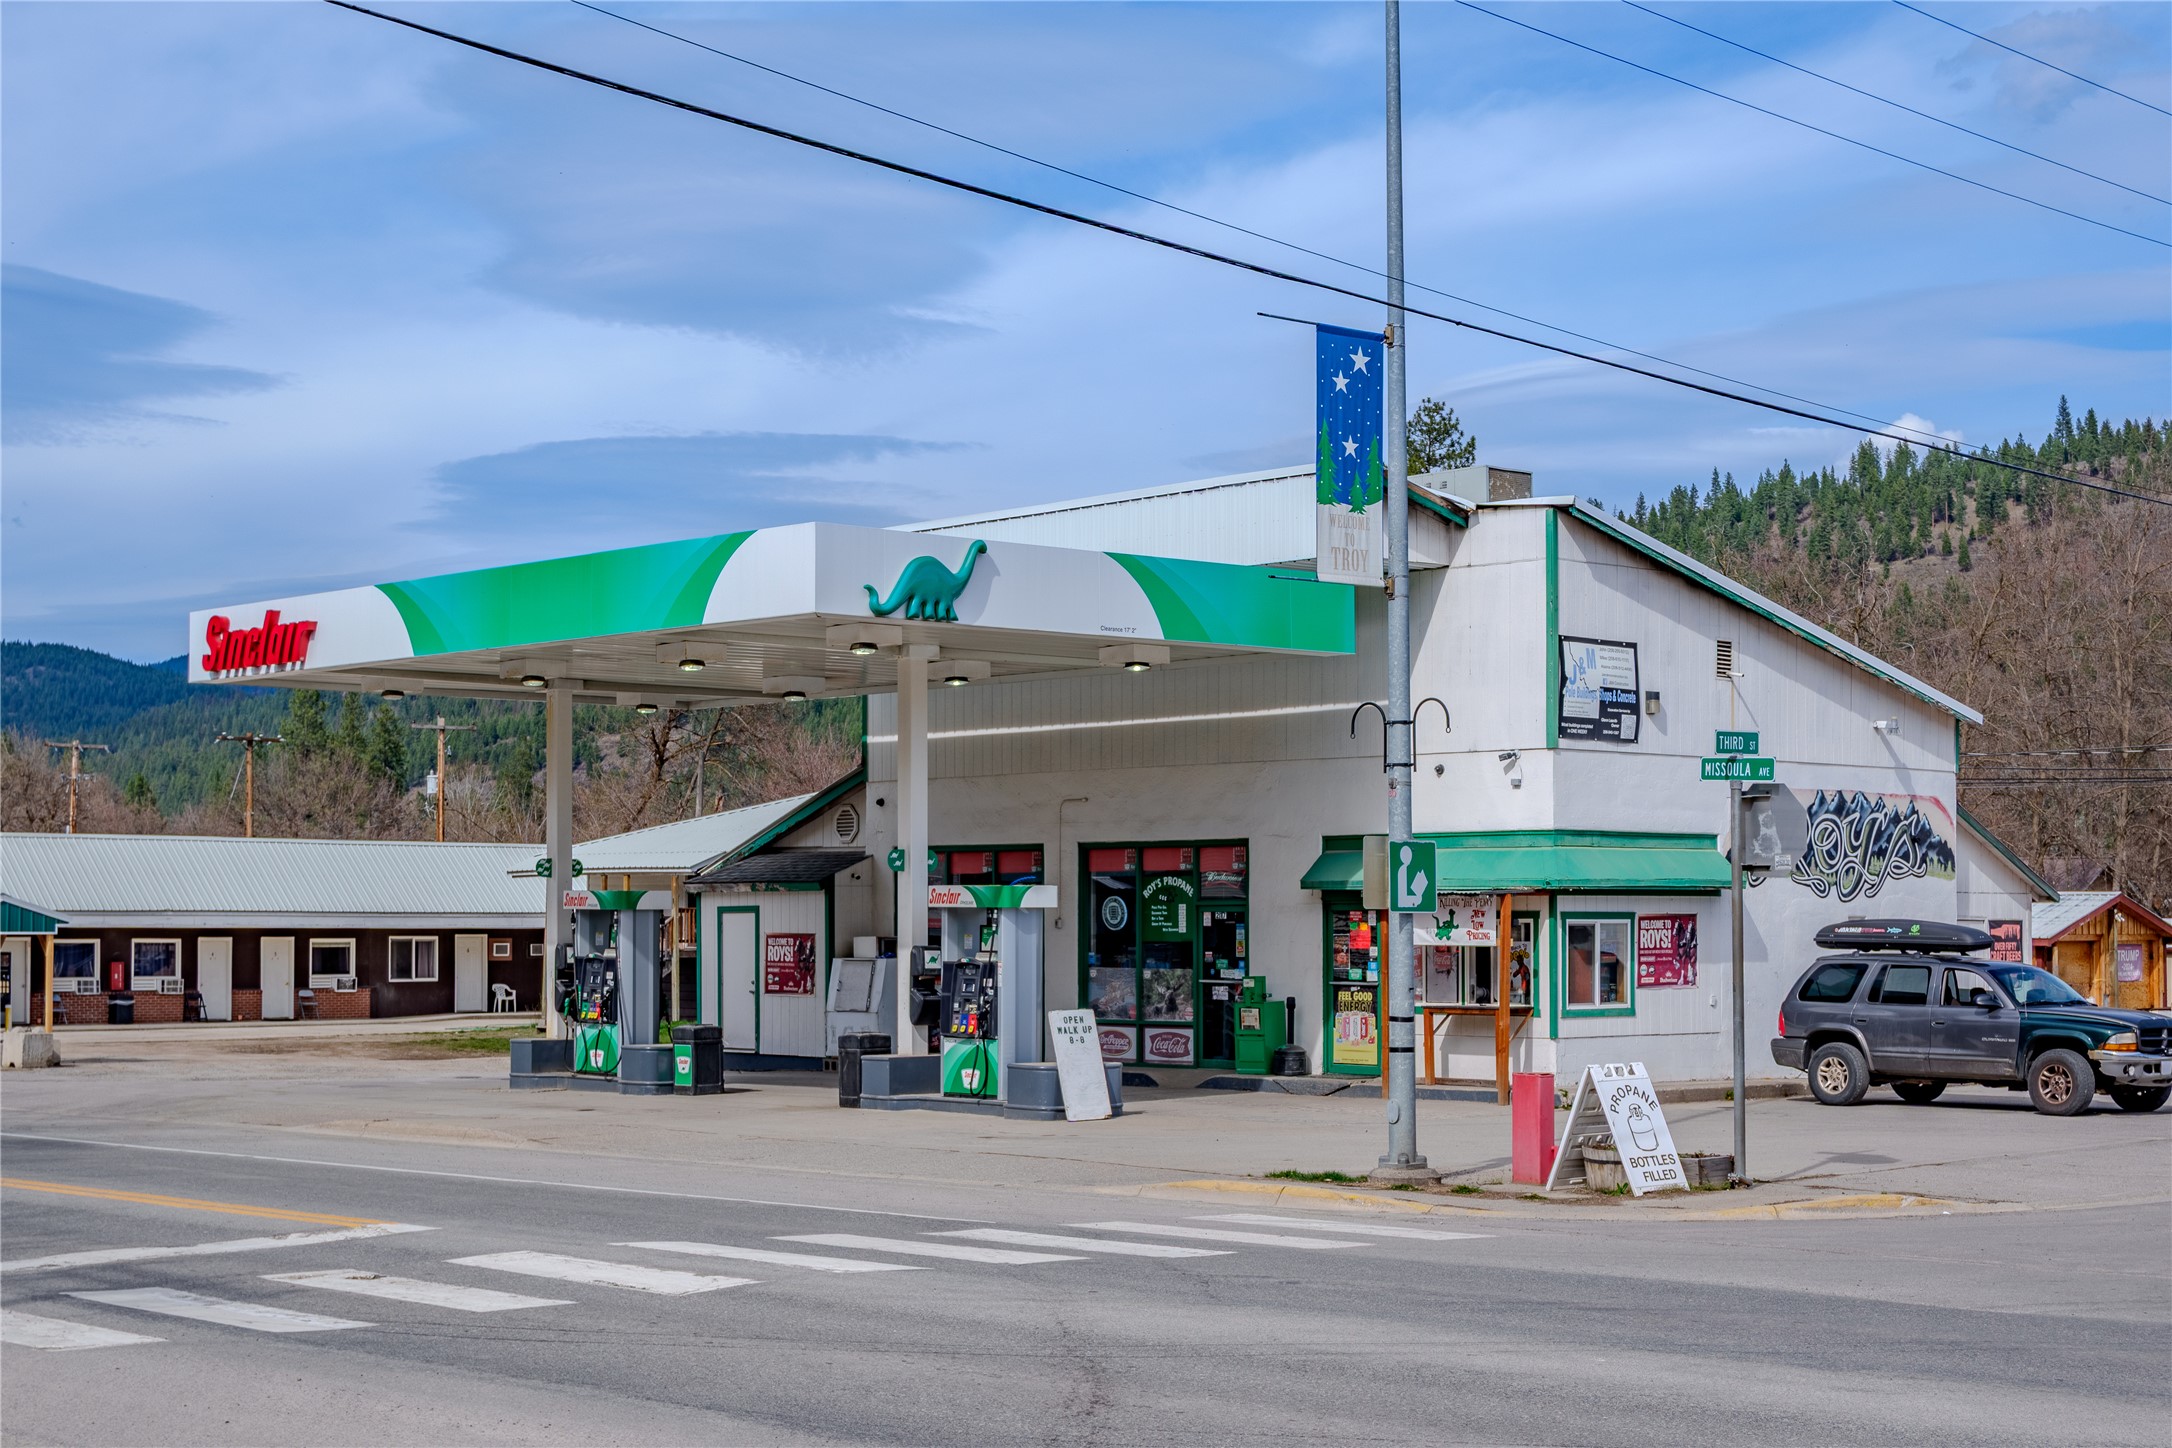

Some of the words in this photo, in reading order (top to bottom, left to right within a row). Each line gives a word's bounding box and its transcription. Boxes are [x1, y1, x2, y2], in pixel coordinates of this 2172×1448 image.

[1329, 514, 1371, 531] WELCOME
[1344, 532, 1355, 547] TO
[1330, 547, 1369, 573] TROY
[202, 609, 318, 673] Sinclair
[1569, 664, 1577, 685] J
[1578, 656, 1586, 676] &
[1586, 647, 1597, 670] M
[1617, 689, 1636, 704] Concrete
[1719, 735, 1744, 750] THIRD
[1749, 741, 1756, 750] ST
[1705, 762, 1751, 776] MISSOULA
[1758, 767, 1770, 777] AVE
[1142, 878, 1162, 898] ROY'S
[1163, 876, 1194, 897] PROPANE
[564, 892, 588, 907] Sinclair
[929, 887, 961, 904] Sinclair
[1461, 898, 1472, 908] THE
[1471, 909, 1486, 919] NEW
[1471, 920, 1484, 930] LOW
[1641, 920, 1664, 929] WELCOME
[1665, 920, 1671, 929] TO
[788, 938, 794, 946] TO
[1466, 930, 1490, 940] PRICING
[1640, 929, 1671, 948] ROYS!
[1994, 942, 2005, 950] OVER
[2006, 942, 2016, 950] FIFTY
[768, 946, 793, 962] ROYS!
[2007, 951, 2021, 961] BEERS
[2117, 950, 2139, 961] TRUMP
[1338, 991, 1352, 1000] FEEL
[1353, 992, 1372, 1001] GOOD
[1338, 1001, 1373, 1012] ENERGY
[1063, 1016, 1084, 1024] OPEN
[1057, 1026, 1078, 1034] WALK
[1082, 1025, 1092, 1033] UP
[1153, 1036, 1186, 1053] Coca-Cola
[1610, 1084, 1659, 1114] PROPANE
[1629, 1153, 1676, 1169] BOTTLES
[1643, 1168, 1677, 1182] FILLED
